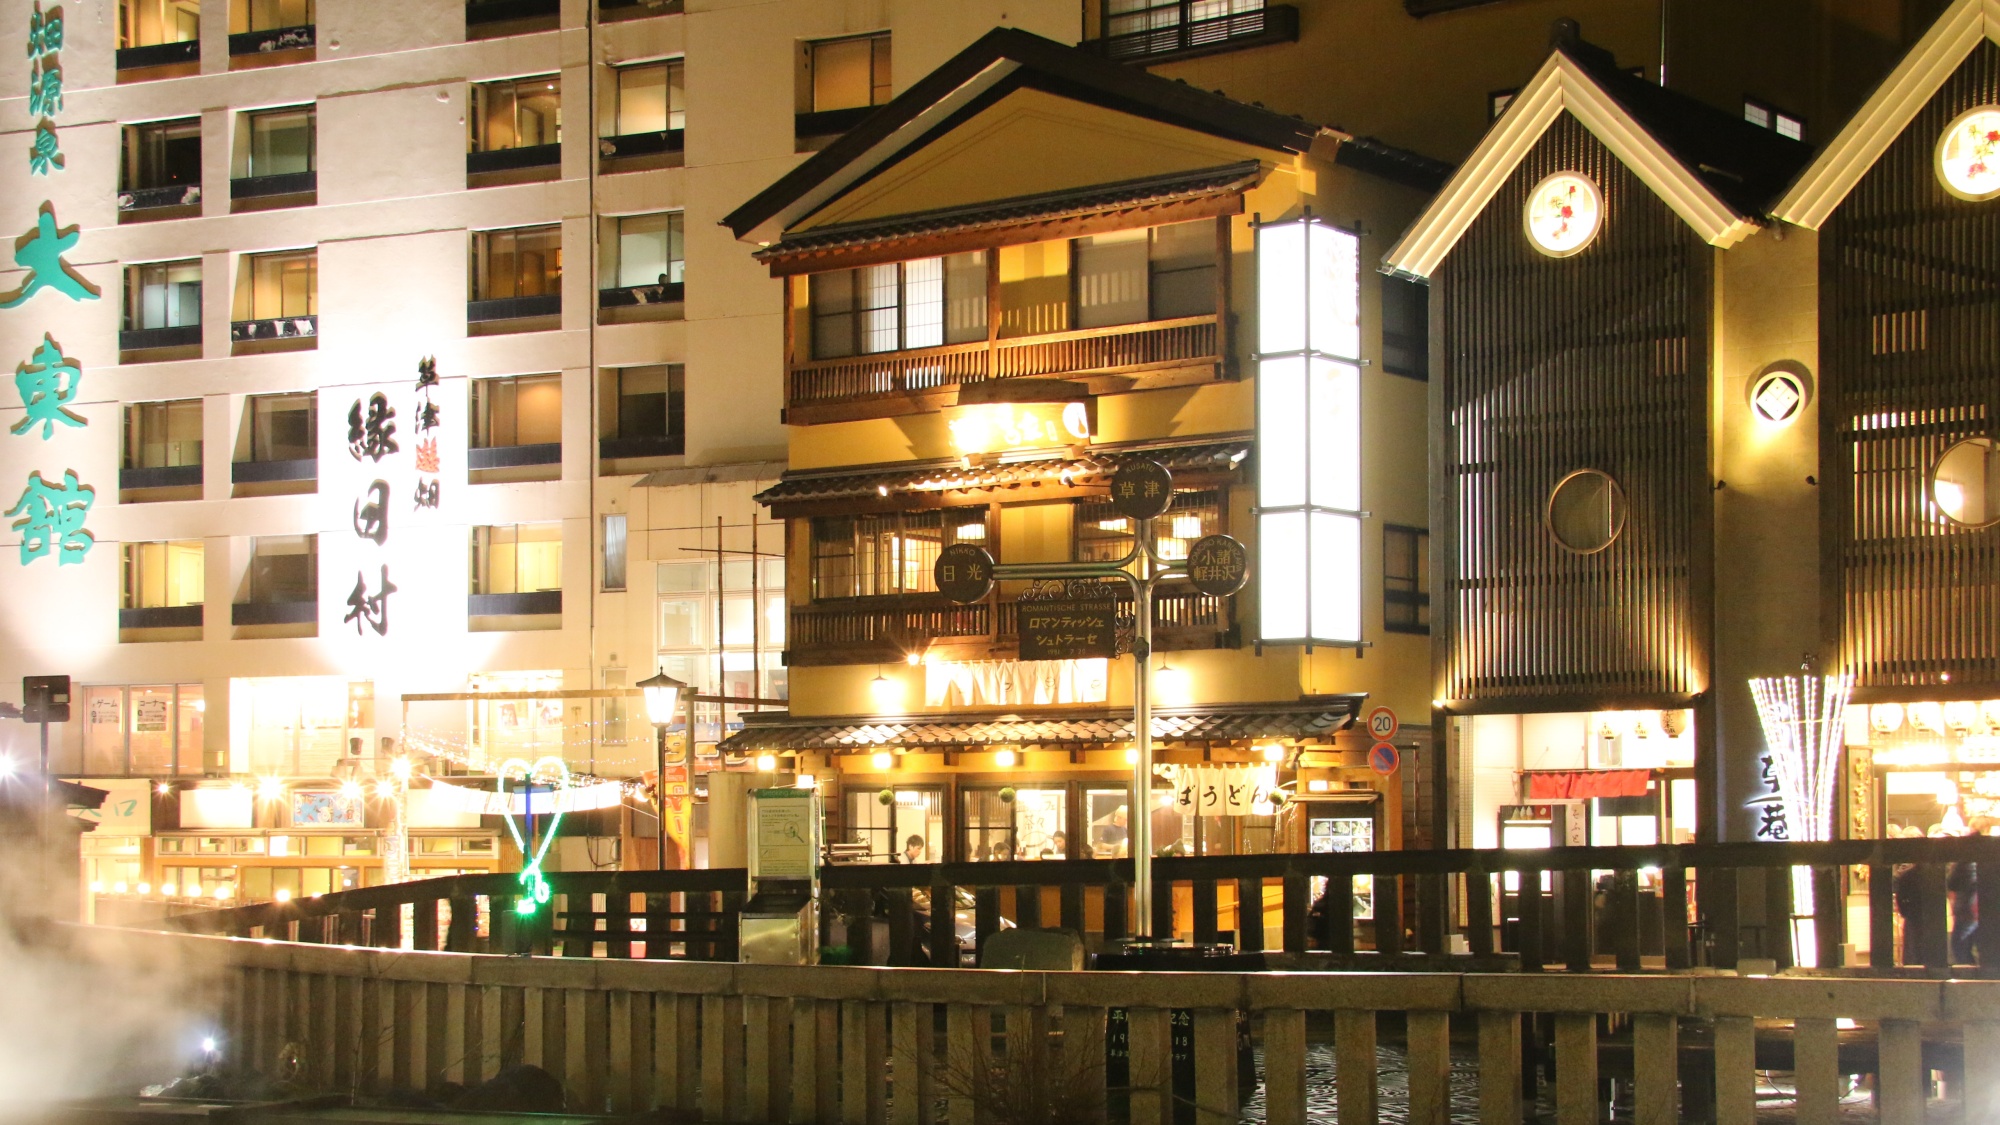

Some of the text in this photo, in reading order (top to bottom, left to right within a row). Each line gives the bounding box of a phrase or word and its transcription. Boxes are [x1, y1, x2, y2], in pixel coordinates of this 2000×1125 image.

[1126, 463, 1155, 473] KUSATU
[1119, 480, 1160, 498] 草津
[950, 547, 975, 556] NIKKO
[1201, 550, 1231, 565] 小諸
[944, 563, 982, 581] 日光
[1193, 566, 1236, 581] 軽井沢
[1022, 603, 1111, 612] ROMANTISCHE STRASSE
[1029, 616, 1105, 629] ロマンティッシェ
[1036, 633, 1098, 645] シュトラーセ
[1374, 716, 1391, 732] 20
